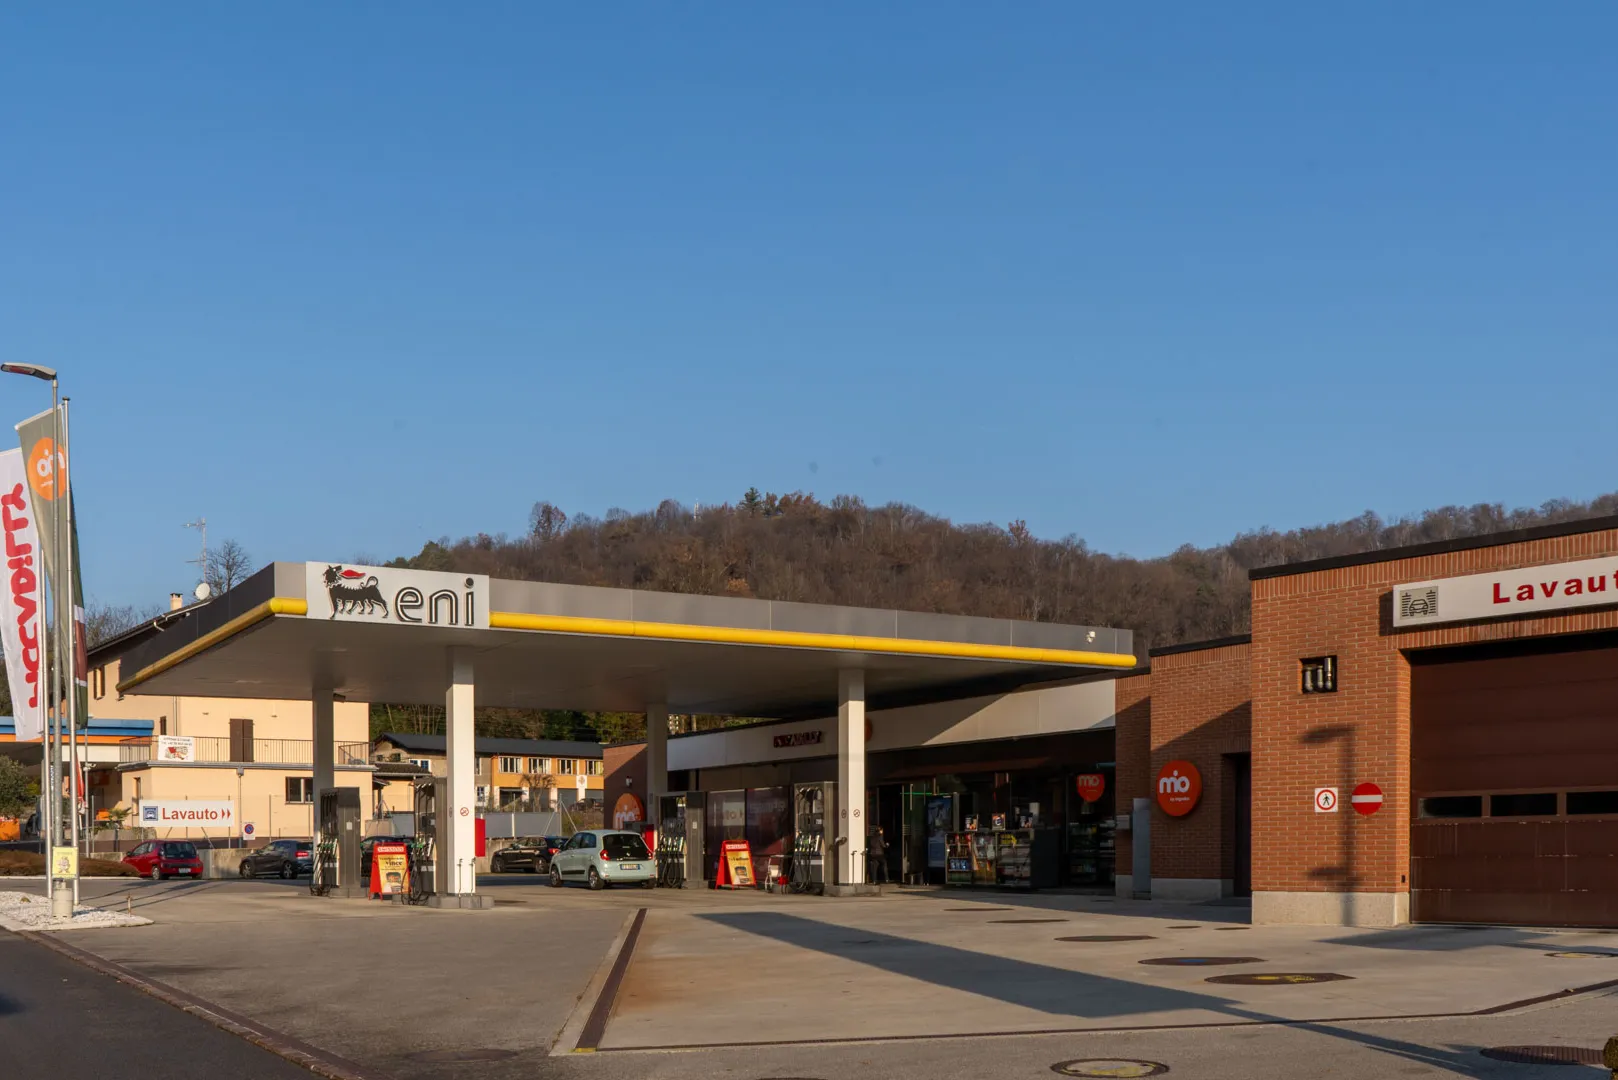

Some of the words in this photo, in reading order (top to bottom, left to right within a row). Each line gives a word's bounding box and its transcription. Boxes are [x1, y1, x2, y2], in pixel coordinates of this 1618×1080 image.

[394, 577, 475, 627] eni
[1159, 769, 1190, 794] mio
[161, 807, 219, 820] Lavauto
